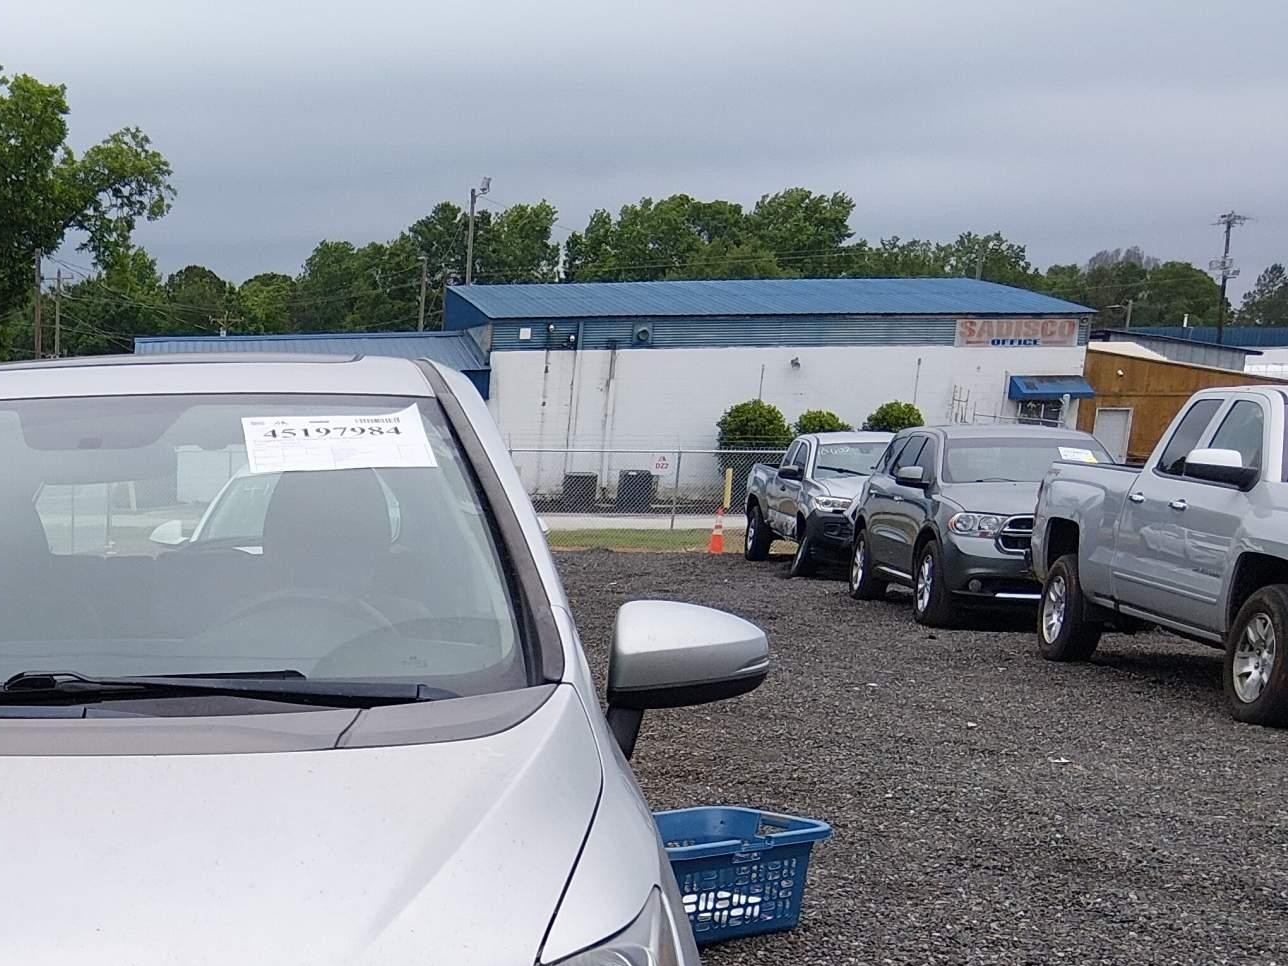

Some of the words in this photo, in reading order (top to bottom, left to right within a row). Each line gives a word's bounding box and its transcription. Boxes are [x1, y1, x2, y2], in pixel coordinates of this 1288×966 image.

[960, 320, 1076, 338] SADISCO
[991, 338, 1041, 346] OFFICE
[263, 425, 403, 439] 45197984
